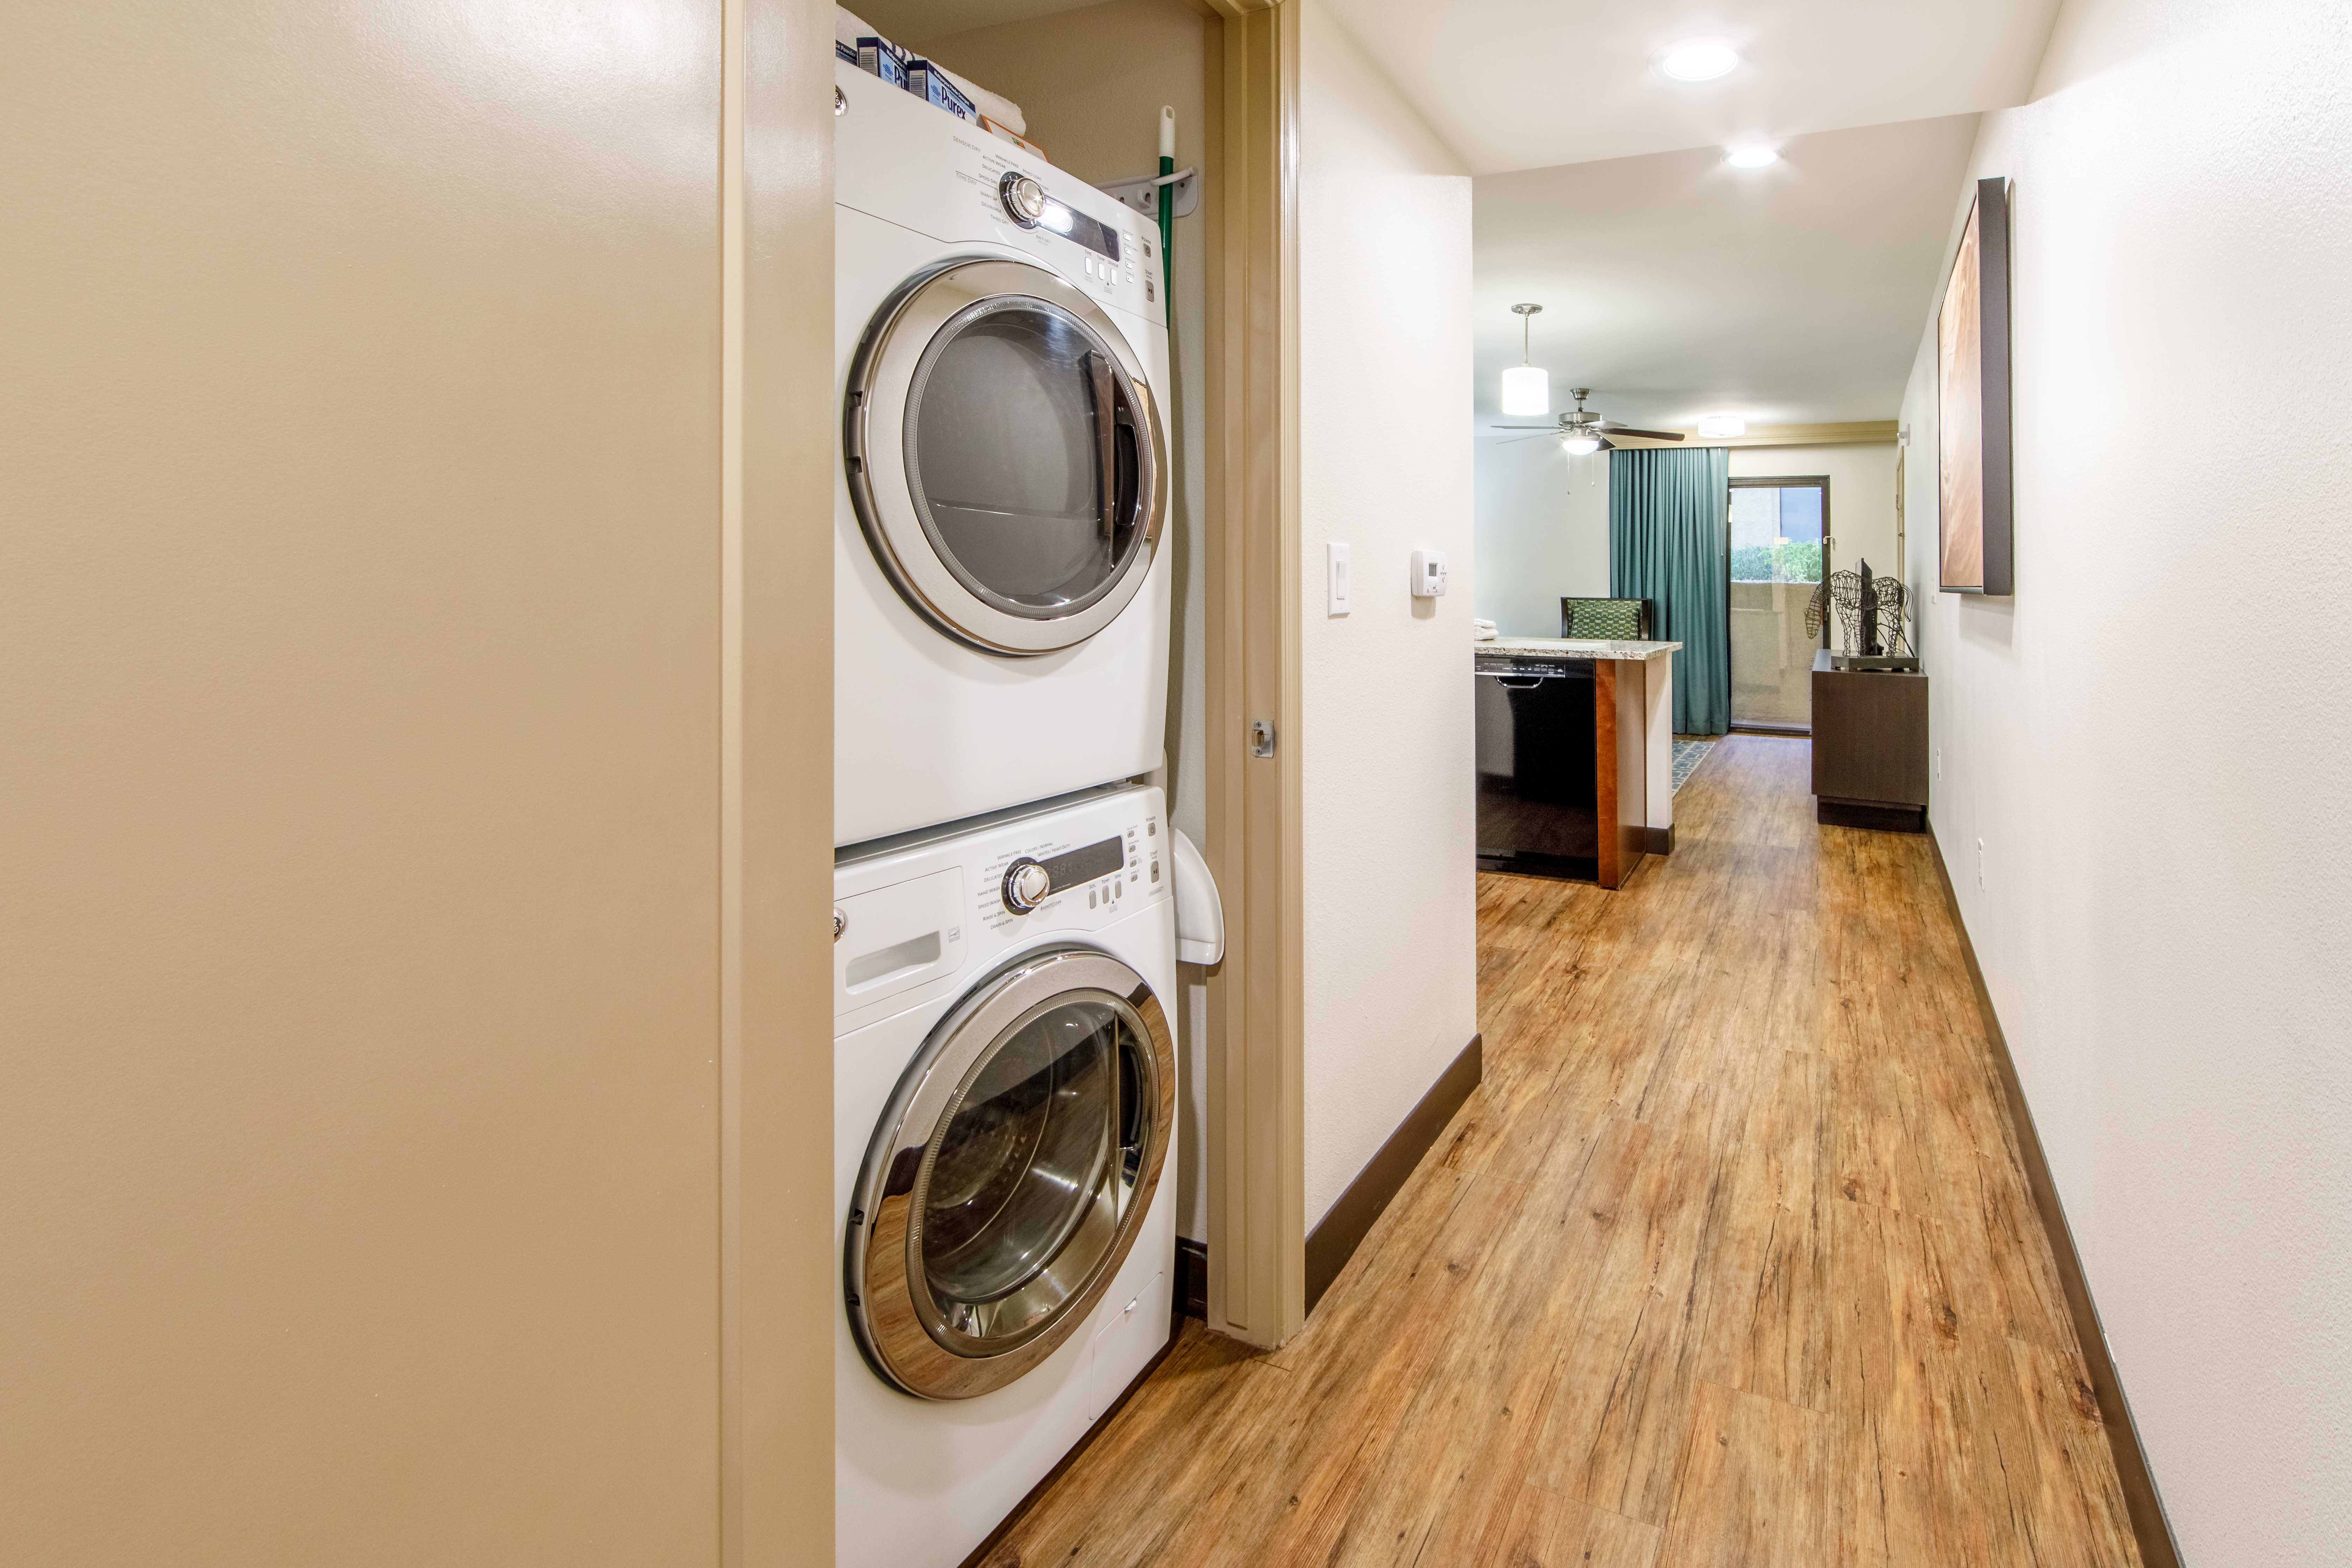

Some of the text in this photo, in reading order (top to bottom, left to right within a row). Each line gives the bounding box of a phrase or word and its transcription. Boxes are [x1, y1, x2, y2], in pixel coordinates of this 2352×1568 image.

[841, 46, 856, 57] Powder
[941, 85, 966, 120] Purex
[953, 136, 971, 148] SENSOR
[983, 155, 1006, 169] ACTIVE WEAR
[995, 154, 1011, 164] WRINKLE
[982, 164, 1001, 175] DELICATES
[1023, 168, 1033, 177] MIXED
[956, 172, 977, 186] TIME DRY
[979, 173, 990, 182] SPEED
[980, 191, 992, 199] WARM
[981, 201, 1002, 214] DEWRINKLE
[1142, 236, 1151, 244] POWER
[1108, 260, 1118, 268] SENSOR
[984, 873, 1003, 882] DELICATES
